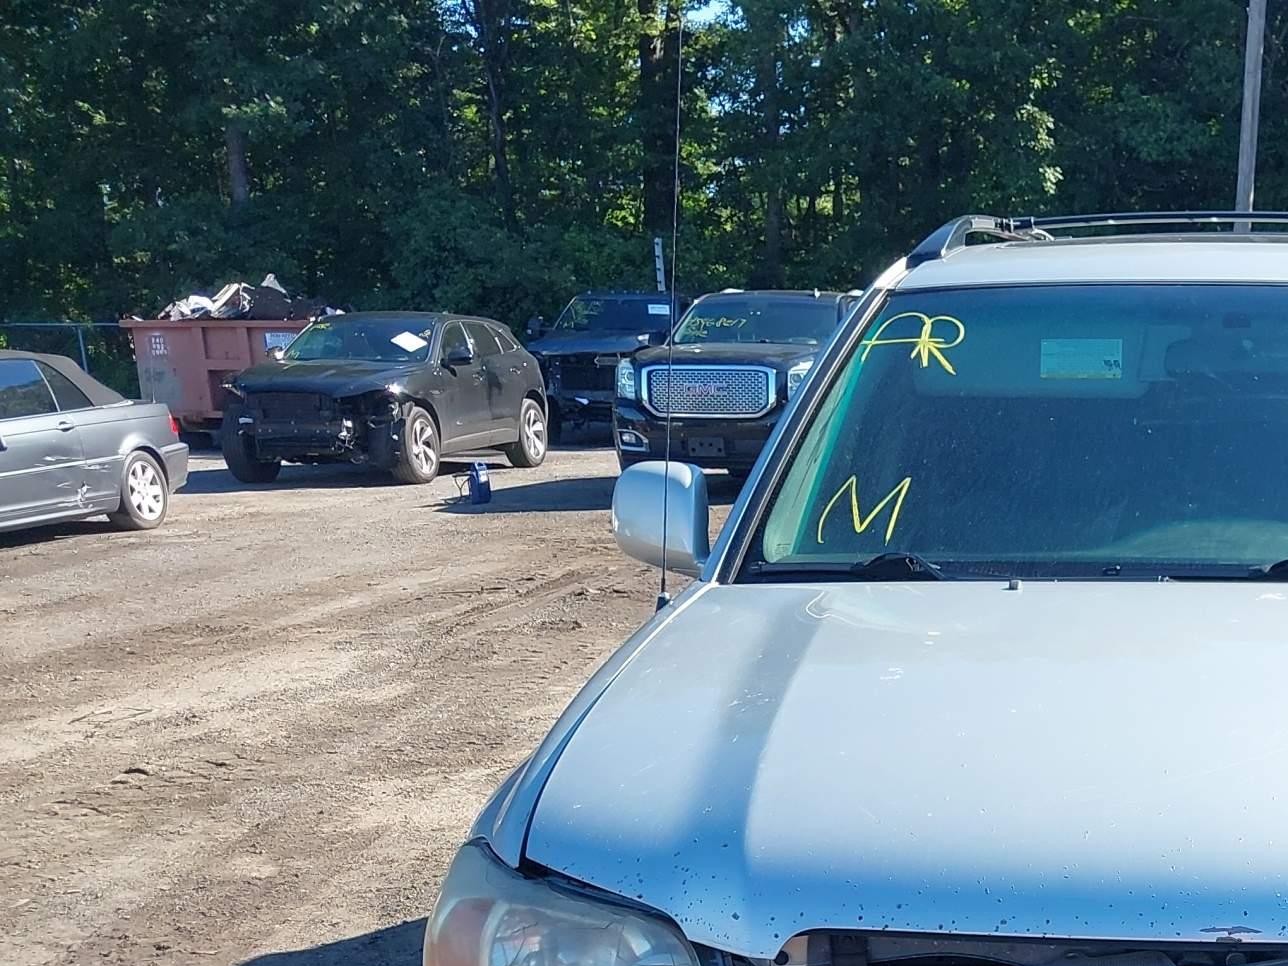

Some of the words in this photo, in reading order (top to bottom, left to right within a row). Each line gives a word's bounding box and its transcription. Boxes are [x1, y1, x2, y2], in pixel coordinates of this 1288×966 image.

[861, 312, 965, 375] AR
[684, 384, 727, 395] GMC
[818, 475, 912, 546] M
